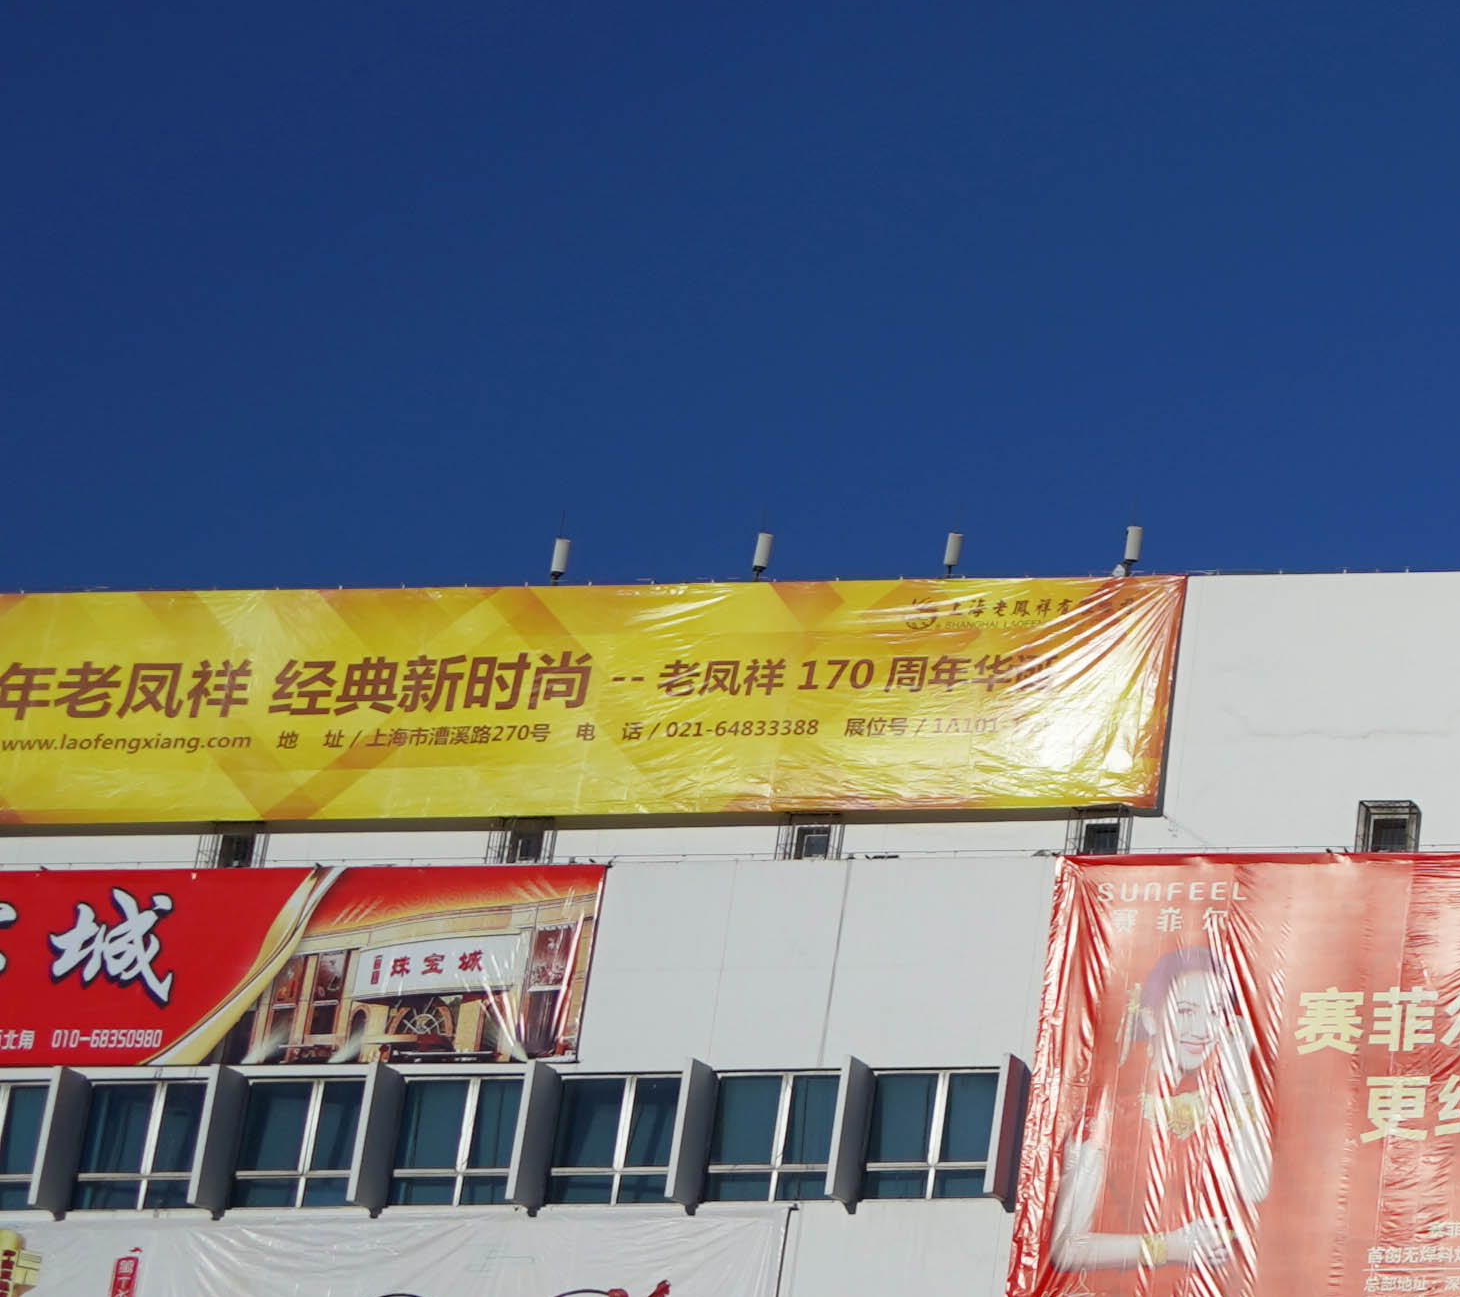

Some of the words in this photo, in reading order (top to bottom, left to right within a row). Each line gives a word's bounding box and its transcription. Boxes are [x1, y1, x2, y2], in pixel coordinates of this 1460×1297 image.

[0, 658, 252, 721] 年老凤祥
[268, 651, 594, 717] 经典新时尚
[656, 659, 785, 698] 老凤祥
[800, 658, 875, 692] 170
[1, 733, 252, 756] www.laofengxiang.com
[277, 730, 298, 749] 地
[577, 723, 596, 742] 电
[1098, 881, 1249, 903] SUNFEEL
[390, 948, 485, 976] 珠宝城
[0, 1029, 34, 1050] 北角
[51, 1027, 162, 1049] 010-68350980
